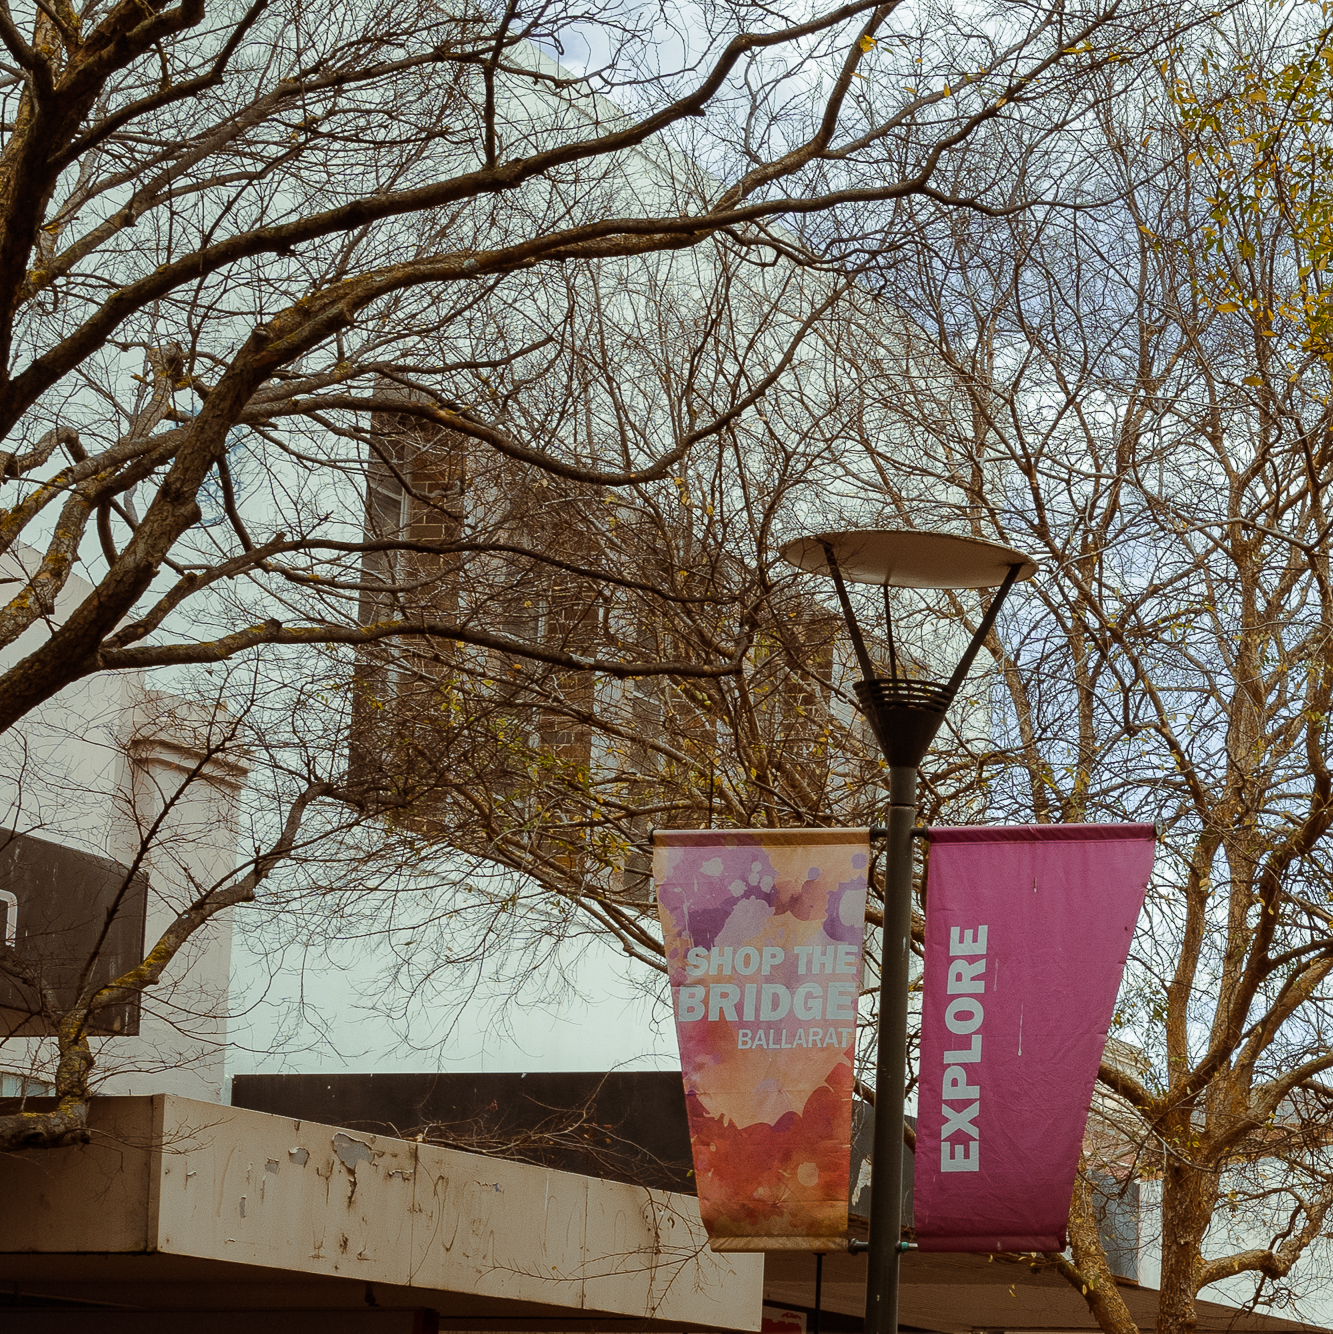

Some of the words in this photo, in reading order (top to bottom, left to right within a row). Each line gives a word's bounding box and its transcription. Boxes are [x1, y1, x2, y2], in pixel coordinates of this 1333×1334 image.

[686, 946, 784, 976] SHOP
[794, 944, 858, 974] THE
[678, 983, 857, 1022] BRIDGE
[738, 1028, 853, 1050] BALLARAT
[940, 924, 990, 1173] EXPLORE
